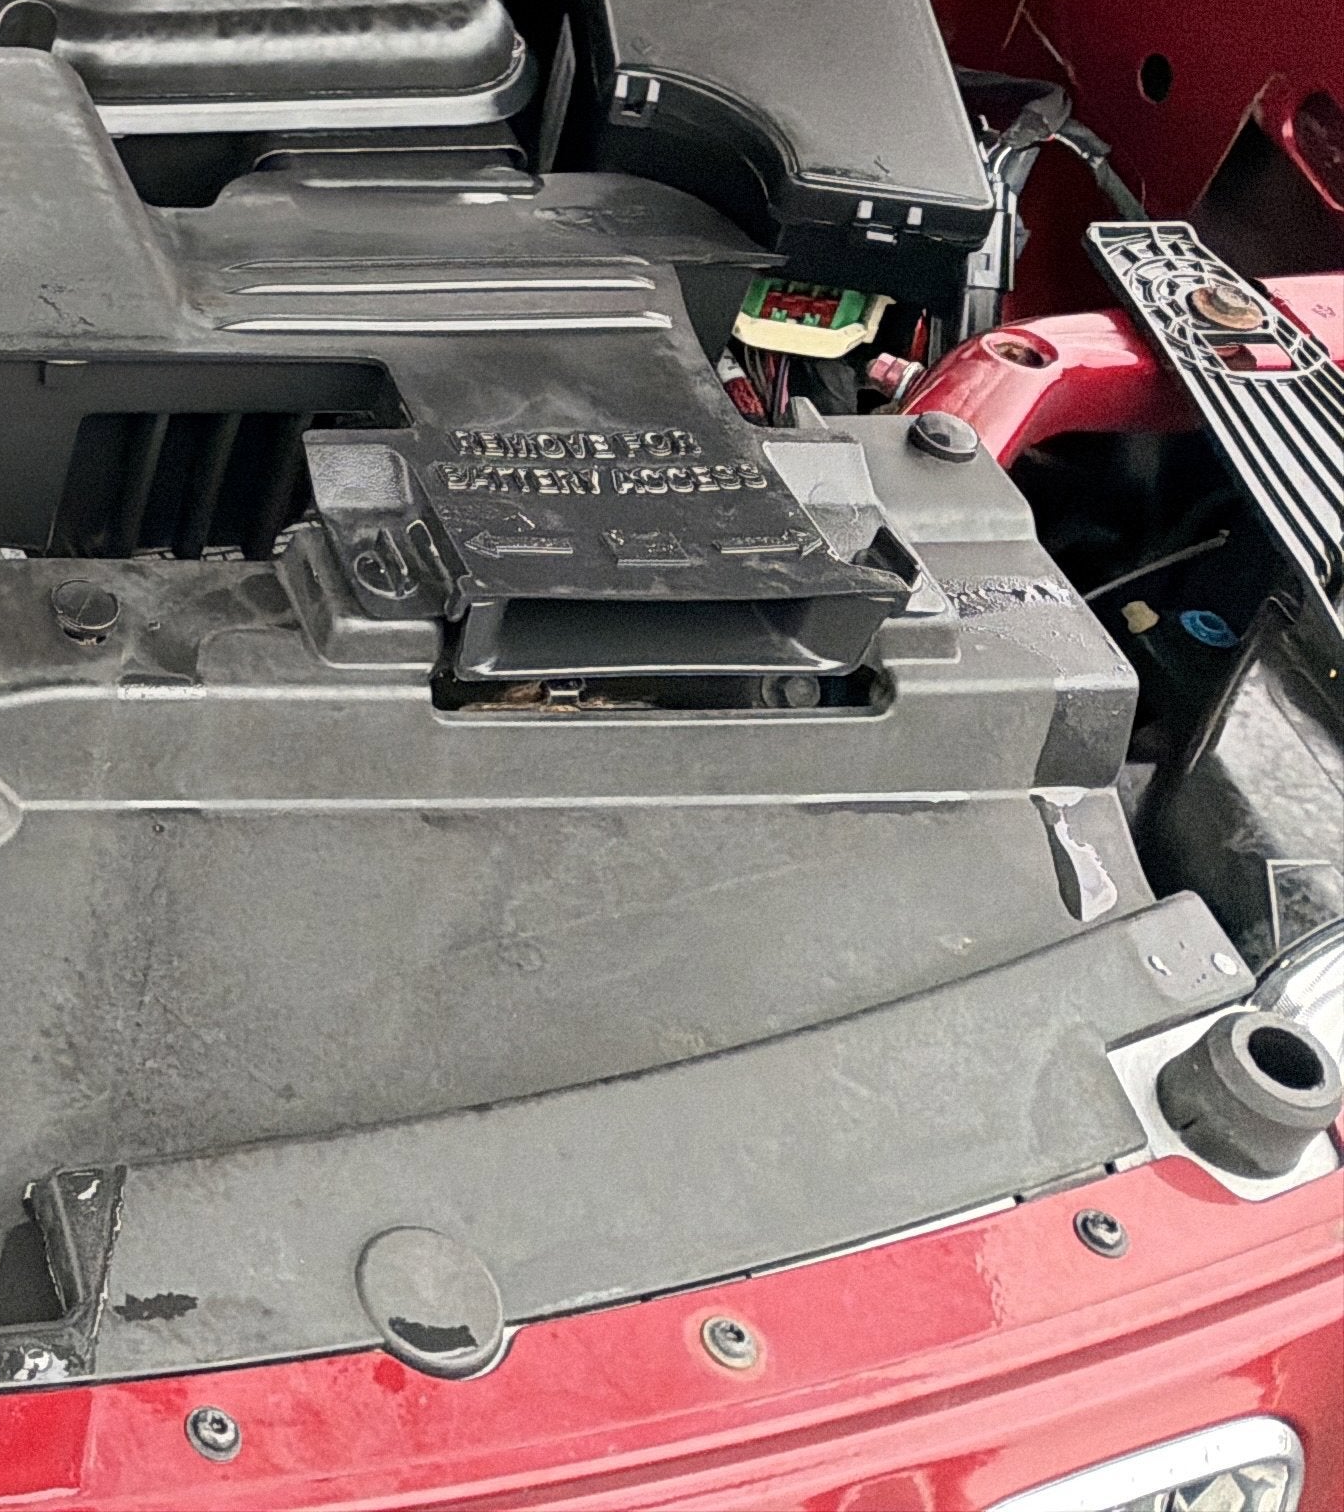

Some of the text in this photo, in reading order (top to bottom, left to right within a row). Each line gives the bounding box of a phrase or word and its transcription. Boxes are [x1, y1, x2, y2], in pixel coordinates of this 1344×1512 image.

[448, 428, 703, 459] REMOVE FOR
[434, 461, 768, 495] BATTERY ACCESS
